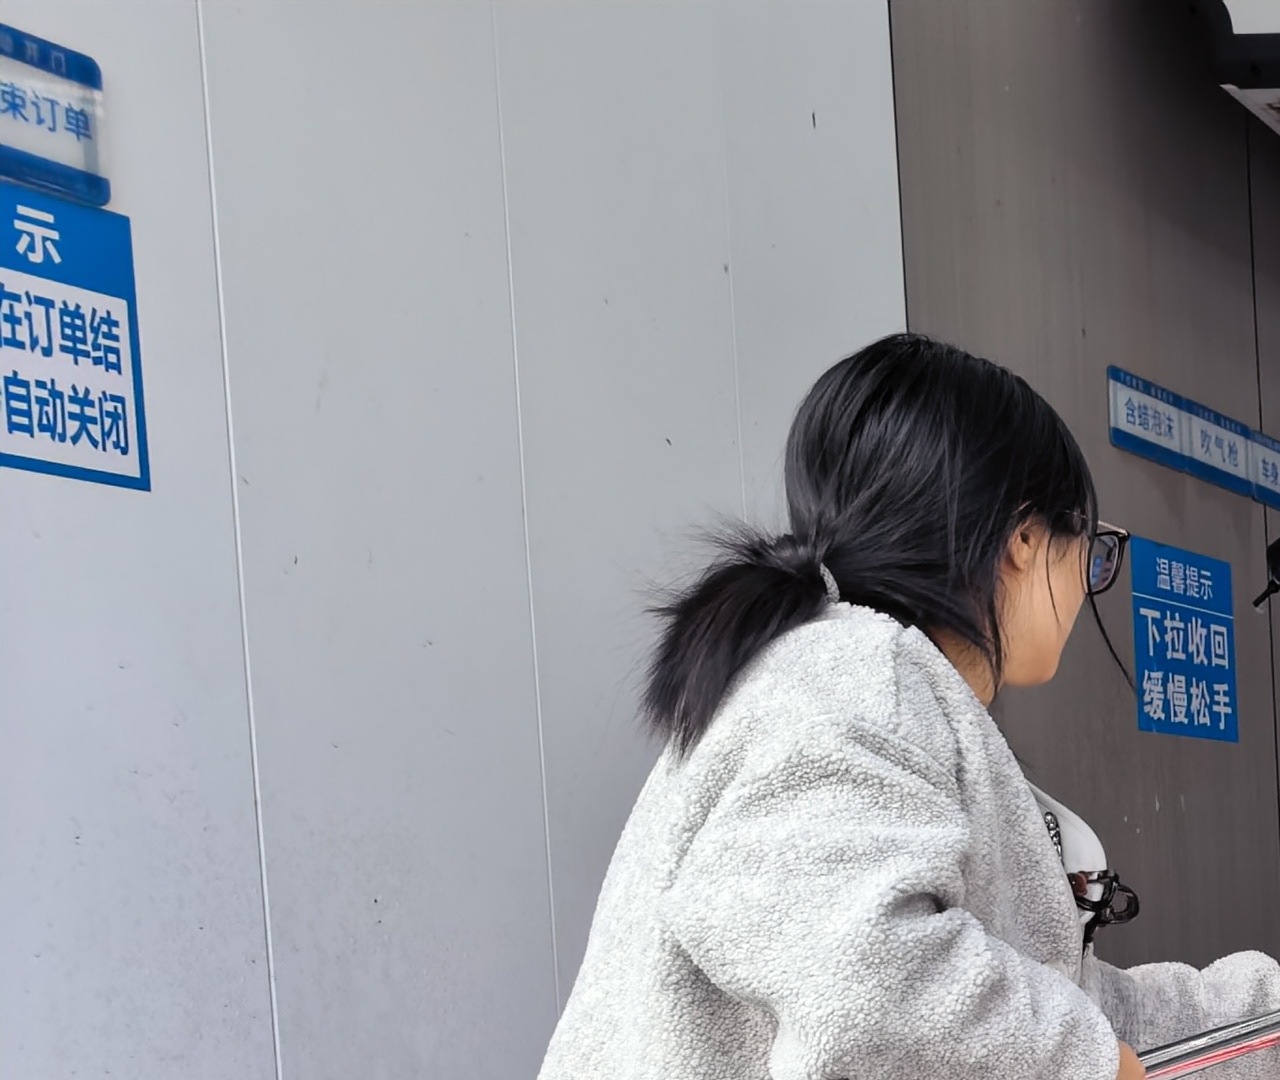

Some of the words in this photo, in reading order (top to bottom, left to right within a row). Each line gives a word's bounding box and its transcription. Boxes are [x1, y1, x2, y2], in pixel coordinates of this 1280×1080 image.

[0, 82, 92, 142] 束订单
[14, 204, 62, 264] 示
[0, 282, 123, 375] 在订单结
[1125, 396, 1176, 441] 含蜡泡沫
[1156, 556, 1213, 600] 温馨提示
[1139, 607, 1229, 670] 下拉收回
[1142, 669, 1232, 730] 缓慢松手
